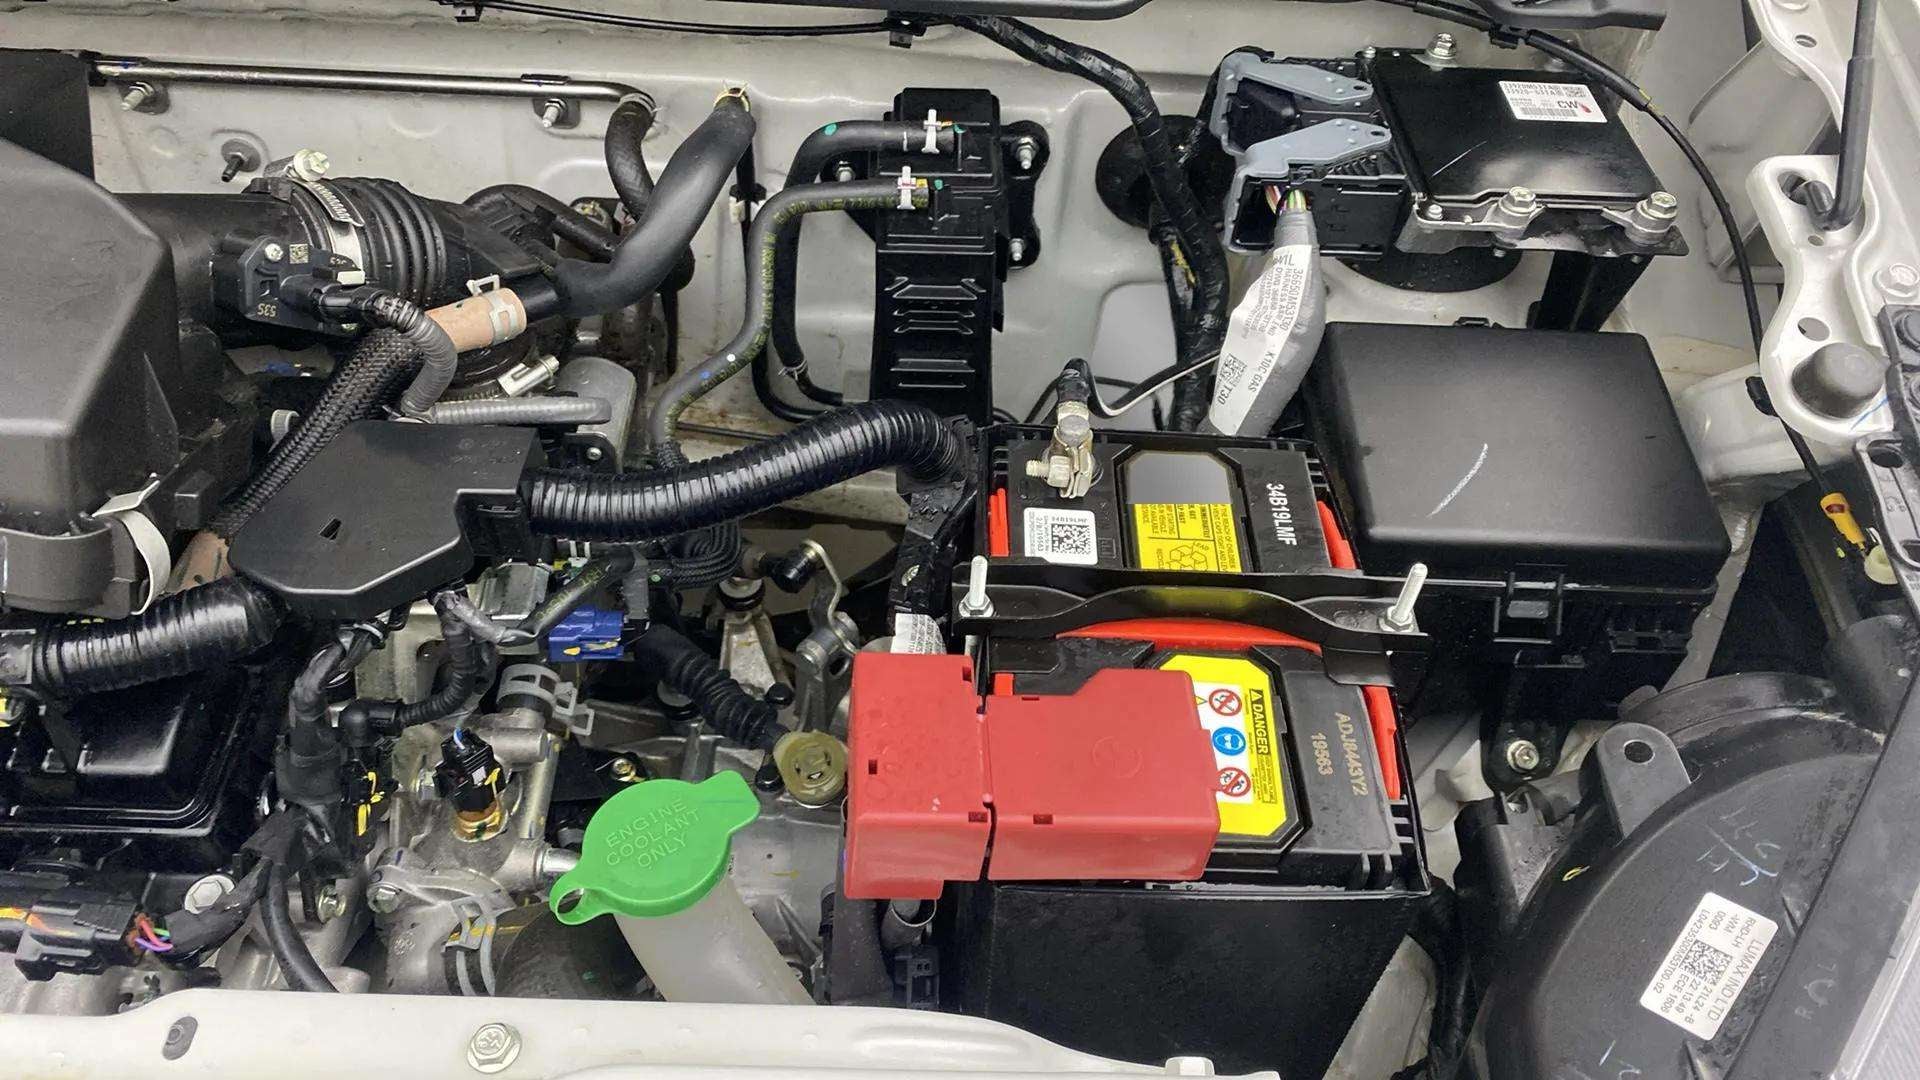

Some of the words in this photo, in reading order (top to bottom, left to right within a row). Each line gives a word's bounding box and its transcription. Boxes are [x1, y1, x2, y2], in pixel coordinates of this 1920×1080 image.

[1558, 100, 1578, 108] CW
[1218, 384, 1233, 405] T30
[1266, 484, 1298, 546] 34B19LMF
[1252, 704, 1268, 754] DANGER
[1310, 732, 1334, 776] 19563
[606, 798, 687, 848] ENGINE
[606, 808, 699, 866] COOLANT
[638, 833, 686, 868] ONLY
[1733, 938, 1764, 977] LUMAX
[1673, 973, 1689, 994] ECE
[1693, 985, 1713, 1012] 21L24
[1721, 974, 1741, 997] IND
[1707, 998, 1726, 1021] LTD
